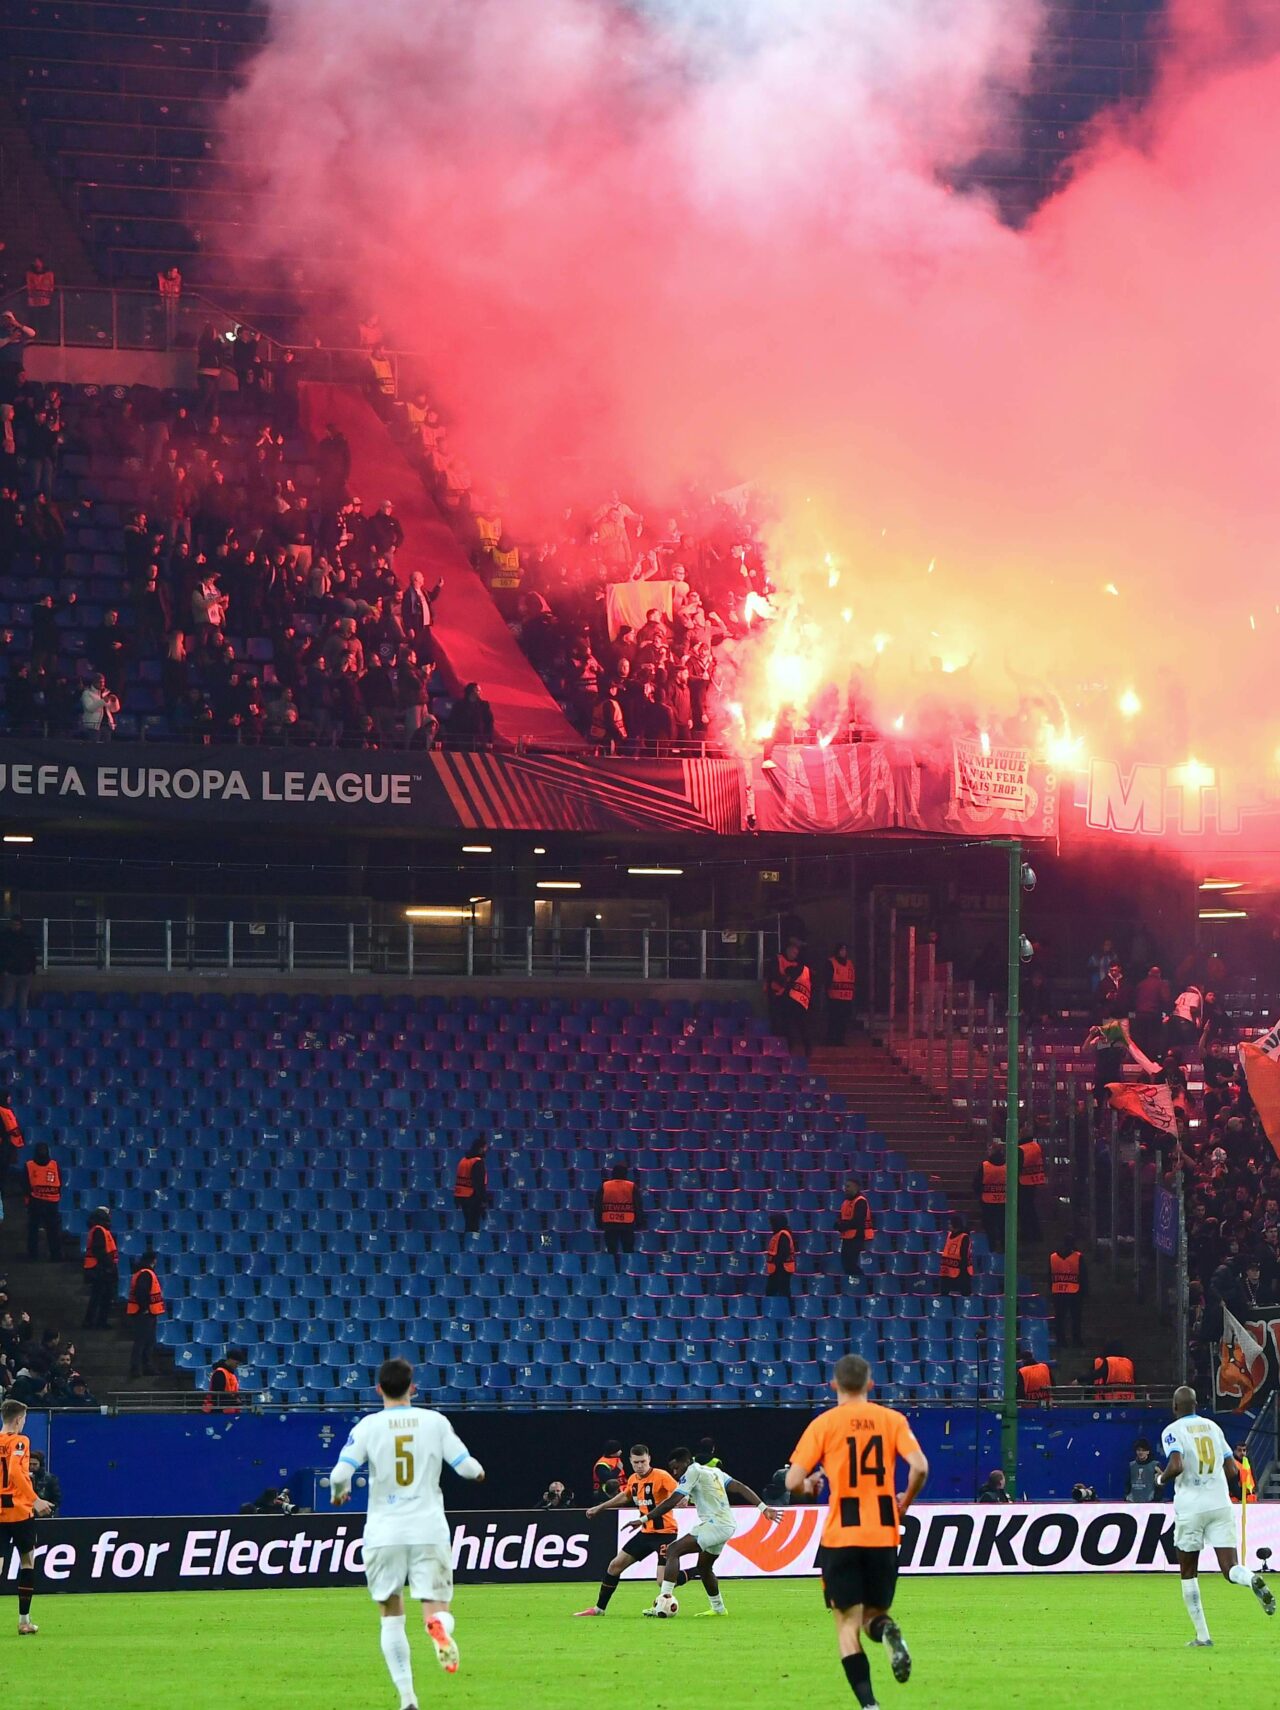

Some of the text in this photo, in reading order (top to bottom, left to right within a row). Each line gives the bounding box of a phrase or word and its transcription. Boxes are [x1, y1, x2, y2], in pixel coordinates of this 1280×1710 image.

[98, 767, 250, 800] EUROPA
[262, 771, 411, 804] LEAGUE
[993, 782, 1017, 794] TROP
[996, 772, 1024, 785] FERA
[394, 1434, 414, 1486] 5
[846, 1435, 885, 1488] 14
[1194, 1436, 1215, 1475] 19
[91, 1530, 170, 1578] for
[179, 1526, 366, 1577] Electric
[452, 1524, 589, 1570] hicles
